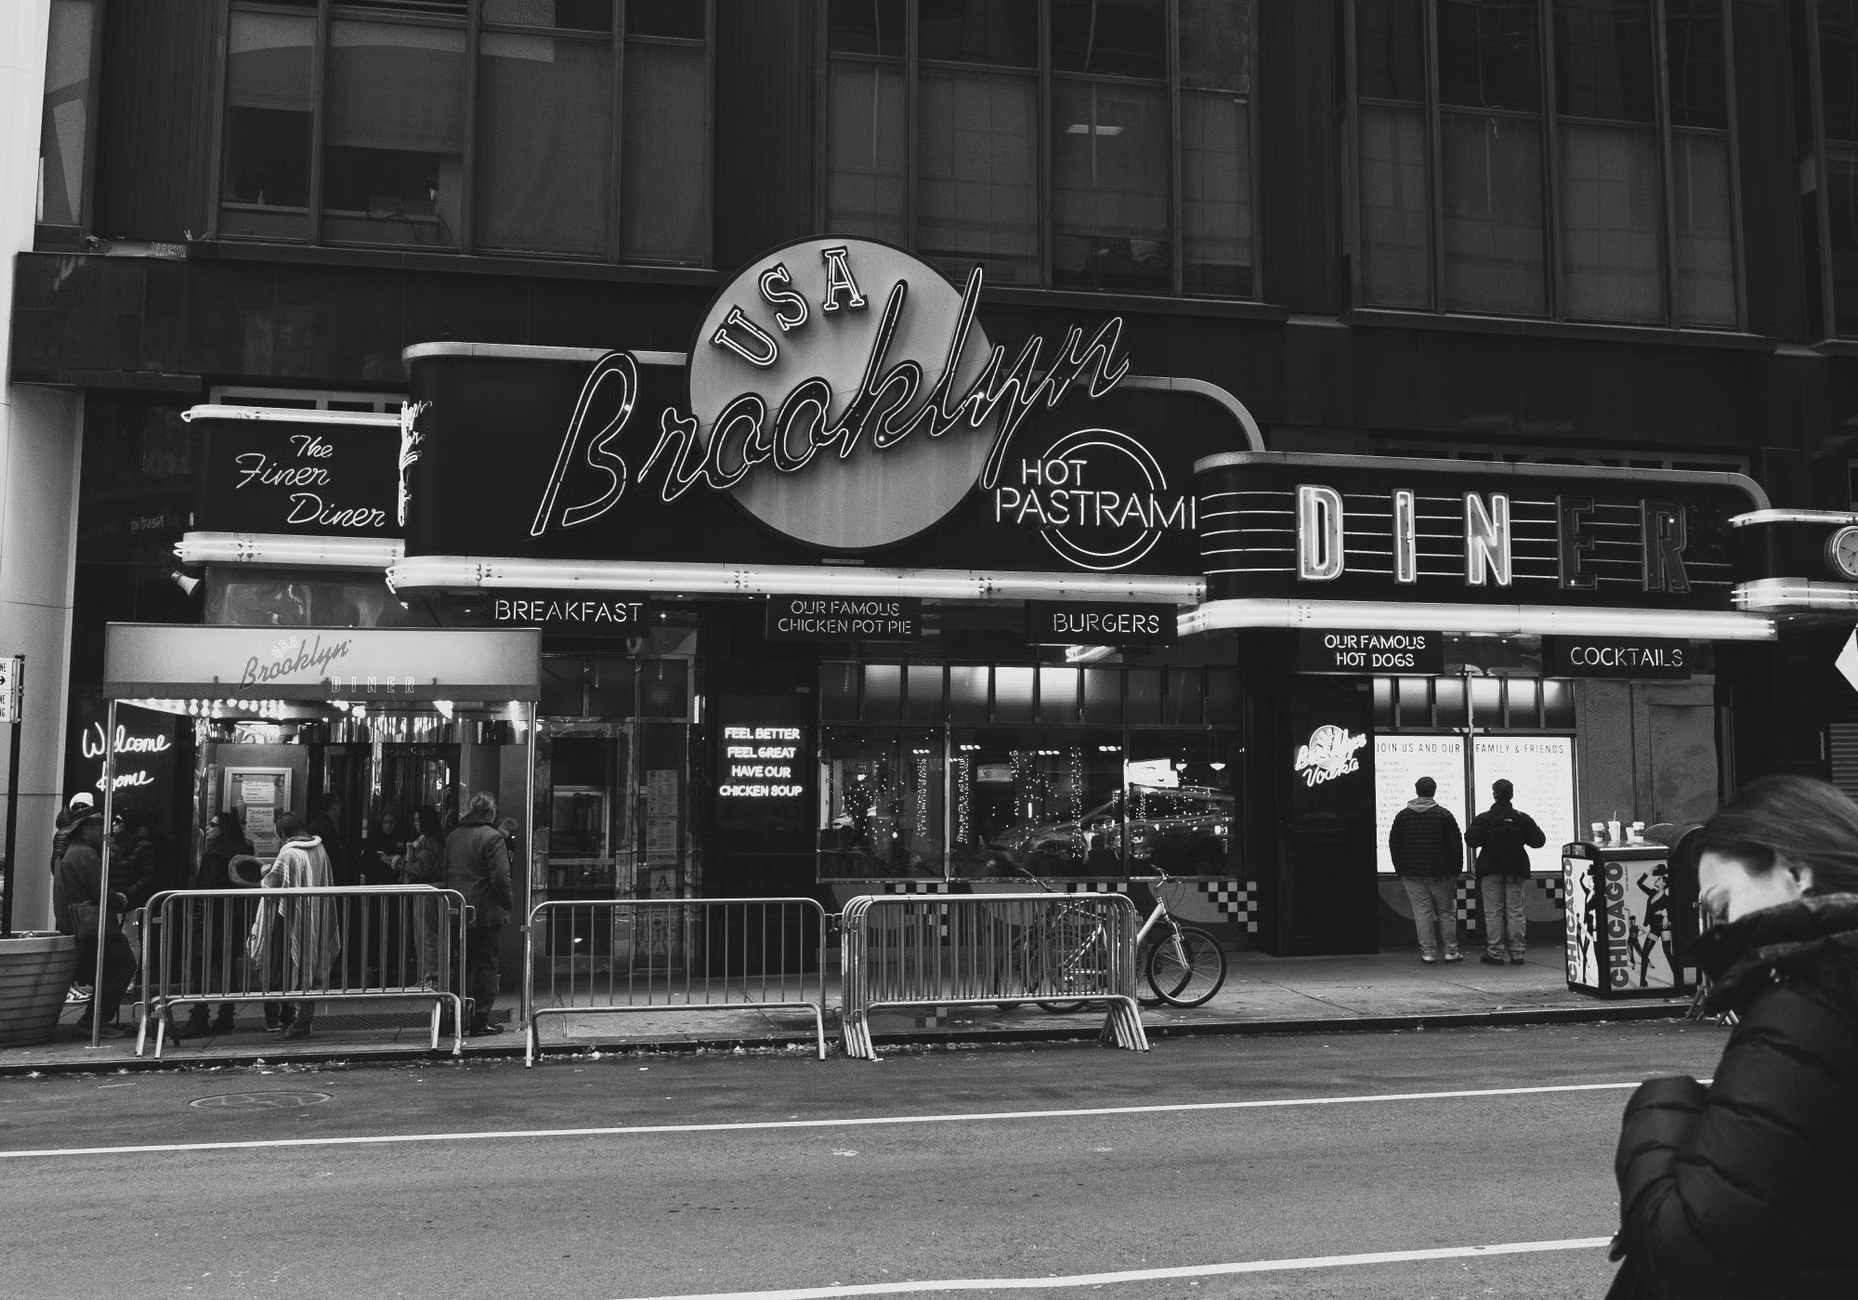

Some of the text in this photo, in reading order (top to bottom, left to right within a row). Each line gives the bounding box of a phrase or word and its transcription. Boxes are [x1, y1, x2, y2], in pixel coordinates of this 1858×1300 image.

[710, 245, 868, 369] USA
[528, 263, 1133, 539] Brooklyn
[290, 433, 333, 459] The
[235, 452, 331, 489] Finer
[1021, 457, 1087, 486] HOT
[286, 492, 386, 529] Diner
[995, 486, 1198, 531] PASTRAMI
[1294, 483, 1692, 594] DINER
[494, 598, 644, 624] BREAKFAST
[790, 600, 899, 618] OUR FAMOUS
[778, 618, 912, 635] CHICKEN POT PIE
[1053, 613, 1160, 635] BURGERS
[1324, 634, 1426, 650] OUR FAMOUS
[239, 634, 349, 690] Brooklyn
[1336, 652, 1415, 667] HOT DOGS
[1570, 646, 1683, 667] COCKTAILS
[331, 676, 416, 694] DINER
[725, 727, 800, 740] FEEL BETTER
[727, 746, 796, 758] FEEL GREAT
[1376, 742, 1461, 753] JOIN US AND OUR
[1475, 743, 1510, 754] FAMILY
[1524, 744, 1565, 754] FRIENDS
[732, 765, 791, 778] HAVE OUR
[720, 785, 803, 797] CHICKEN SOUP
[1563, 858, 1577, 982] CHICAGO
[1605, 862, 1629, 988] CHICAGO
